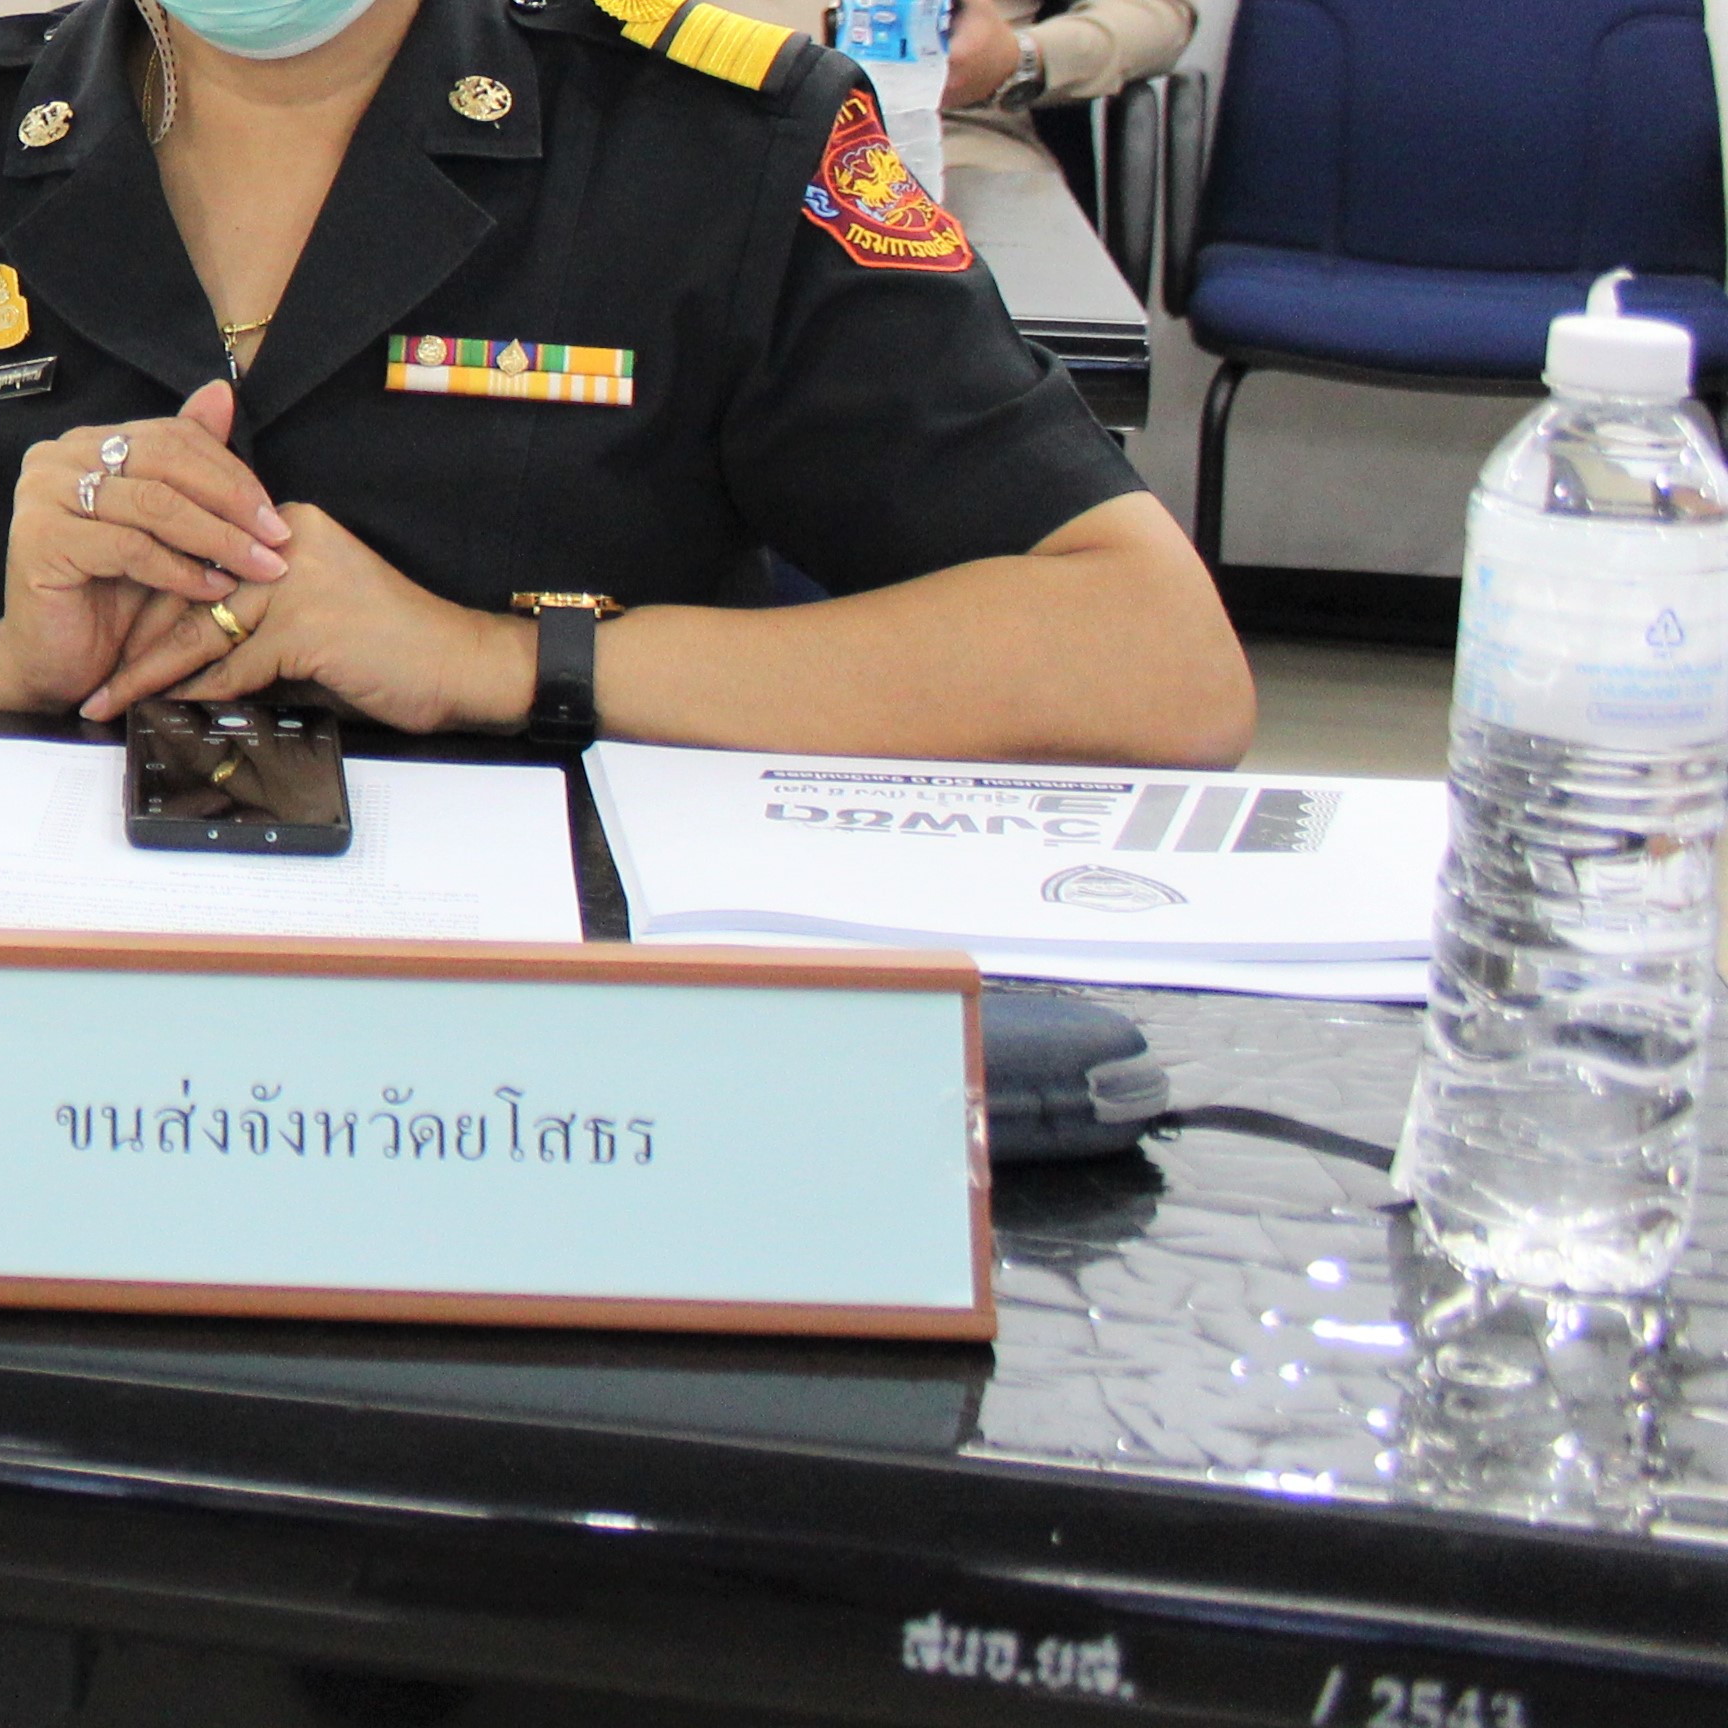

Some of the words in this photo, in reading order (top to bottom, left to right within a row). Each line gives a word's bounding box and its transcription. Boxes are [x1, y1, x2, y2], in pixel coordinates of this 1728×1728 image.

[55, 1078, 657, 1167] ขนส่งจังหวัดยโสธร
